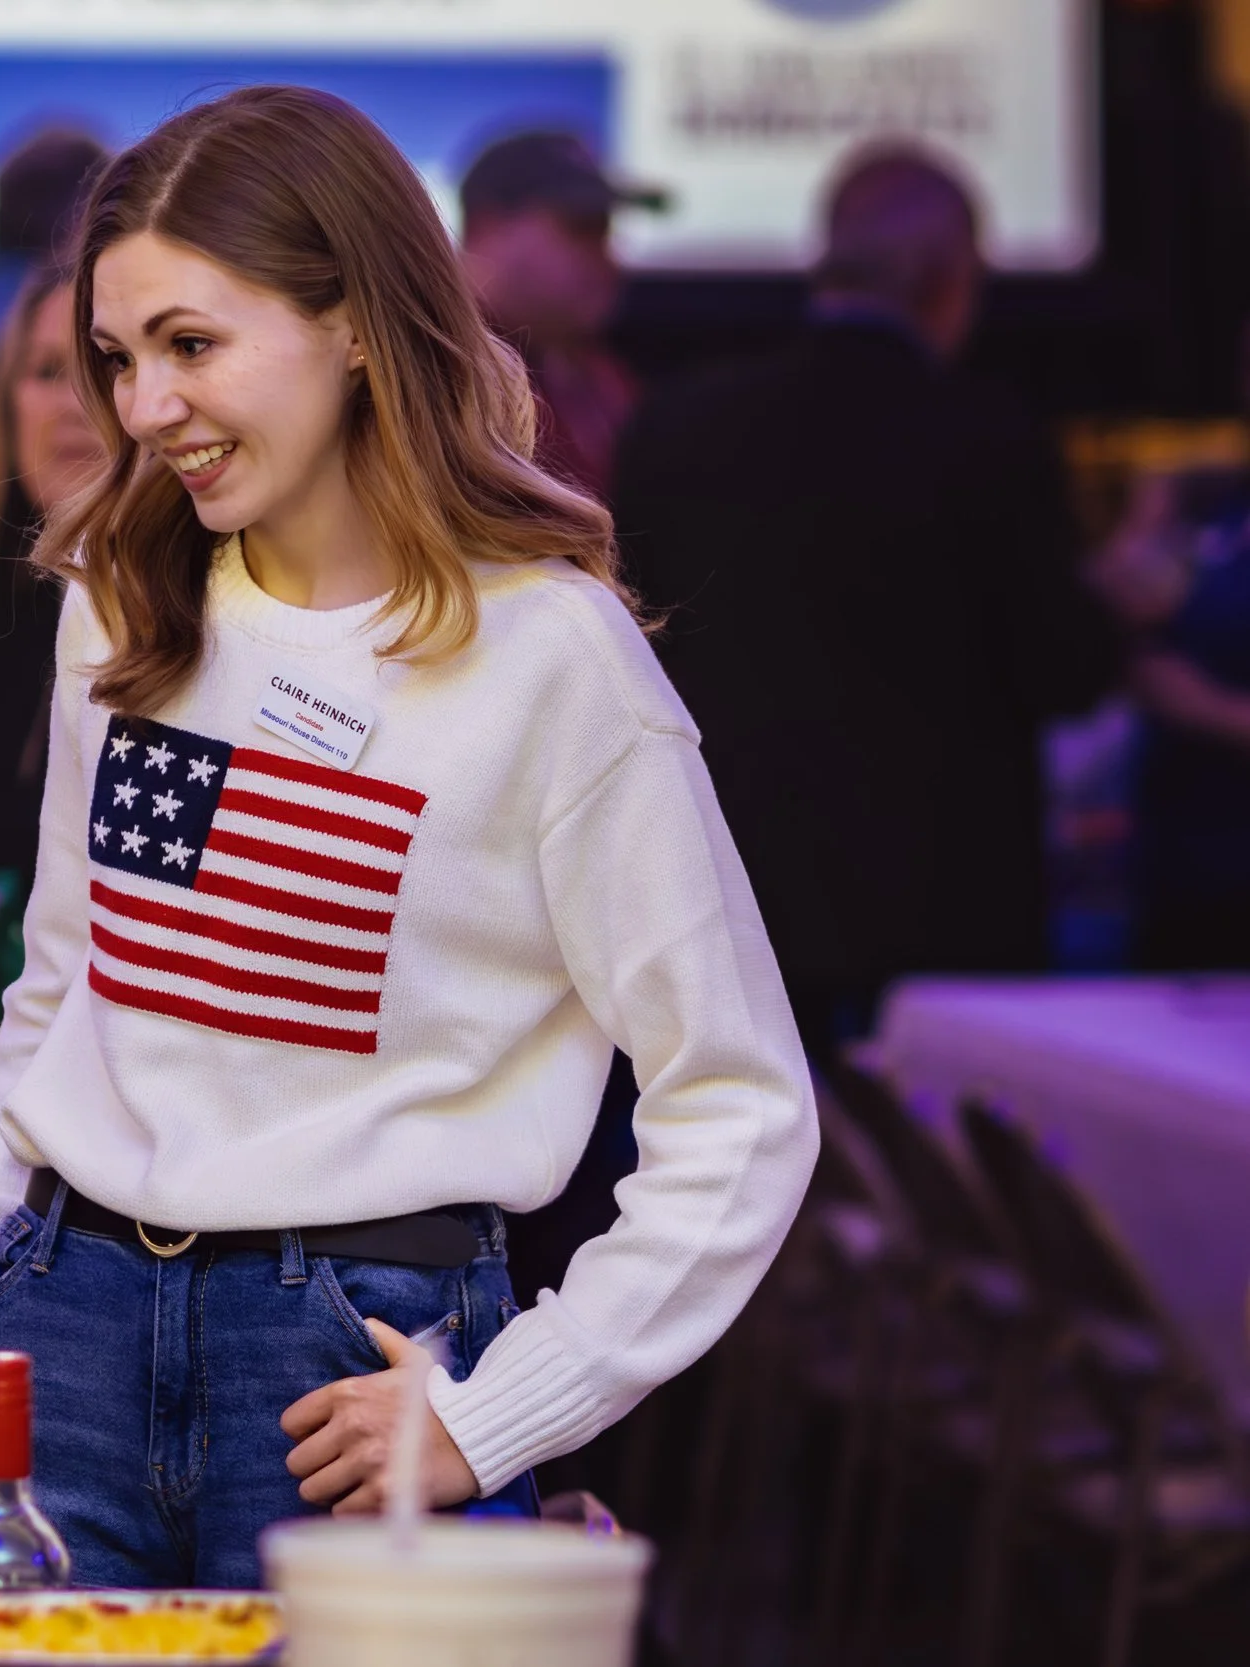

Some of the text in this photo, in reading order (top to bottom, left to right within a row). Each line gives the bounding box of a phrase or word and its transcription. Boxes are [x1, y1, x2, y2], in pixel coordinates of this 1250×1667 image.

[271, 676, 367, 735] CLAIRE HEINRICH
[295, 711, 324, 732] Candidate
[260, 707, 349, 760] Missouri House District 110
